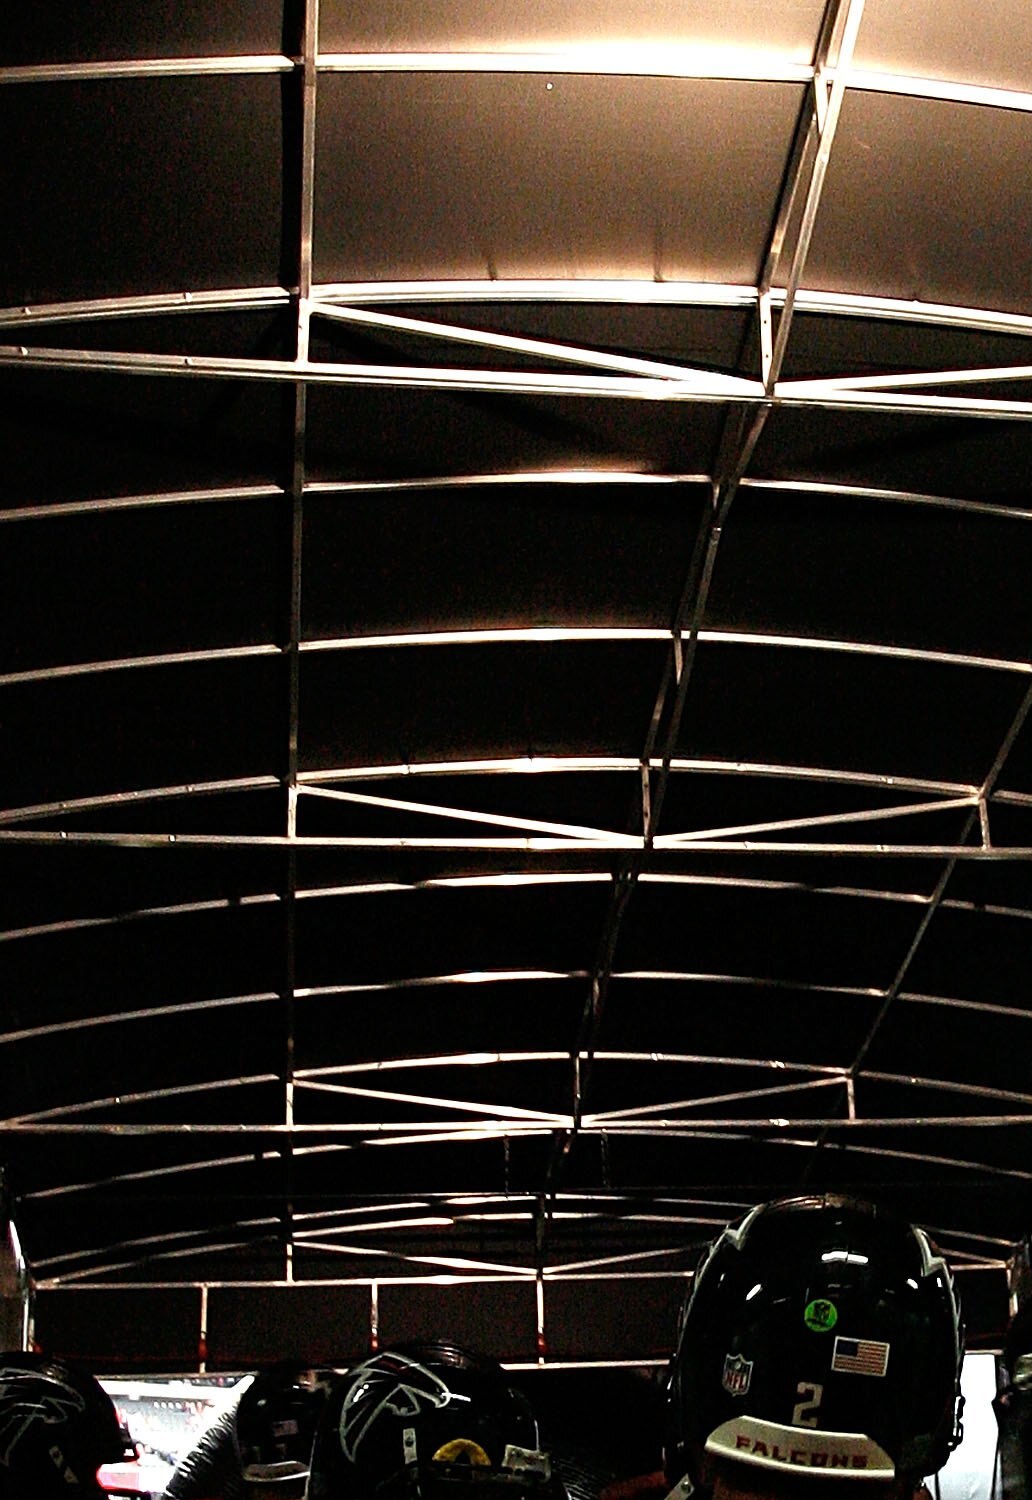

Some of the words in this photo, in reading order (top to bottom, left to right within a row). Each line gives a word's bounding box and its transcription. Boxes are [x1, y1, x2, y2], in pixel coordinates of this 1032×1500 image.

[725, 1372, 745, 1390] NFL
[790, 1381, 824, 1428] 2
[735, 1435, 868, 1468] FALCONS
